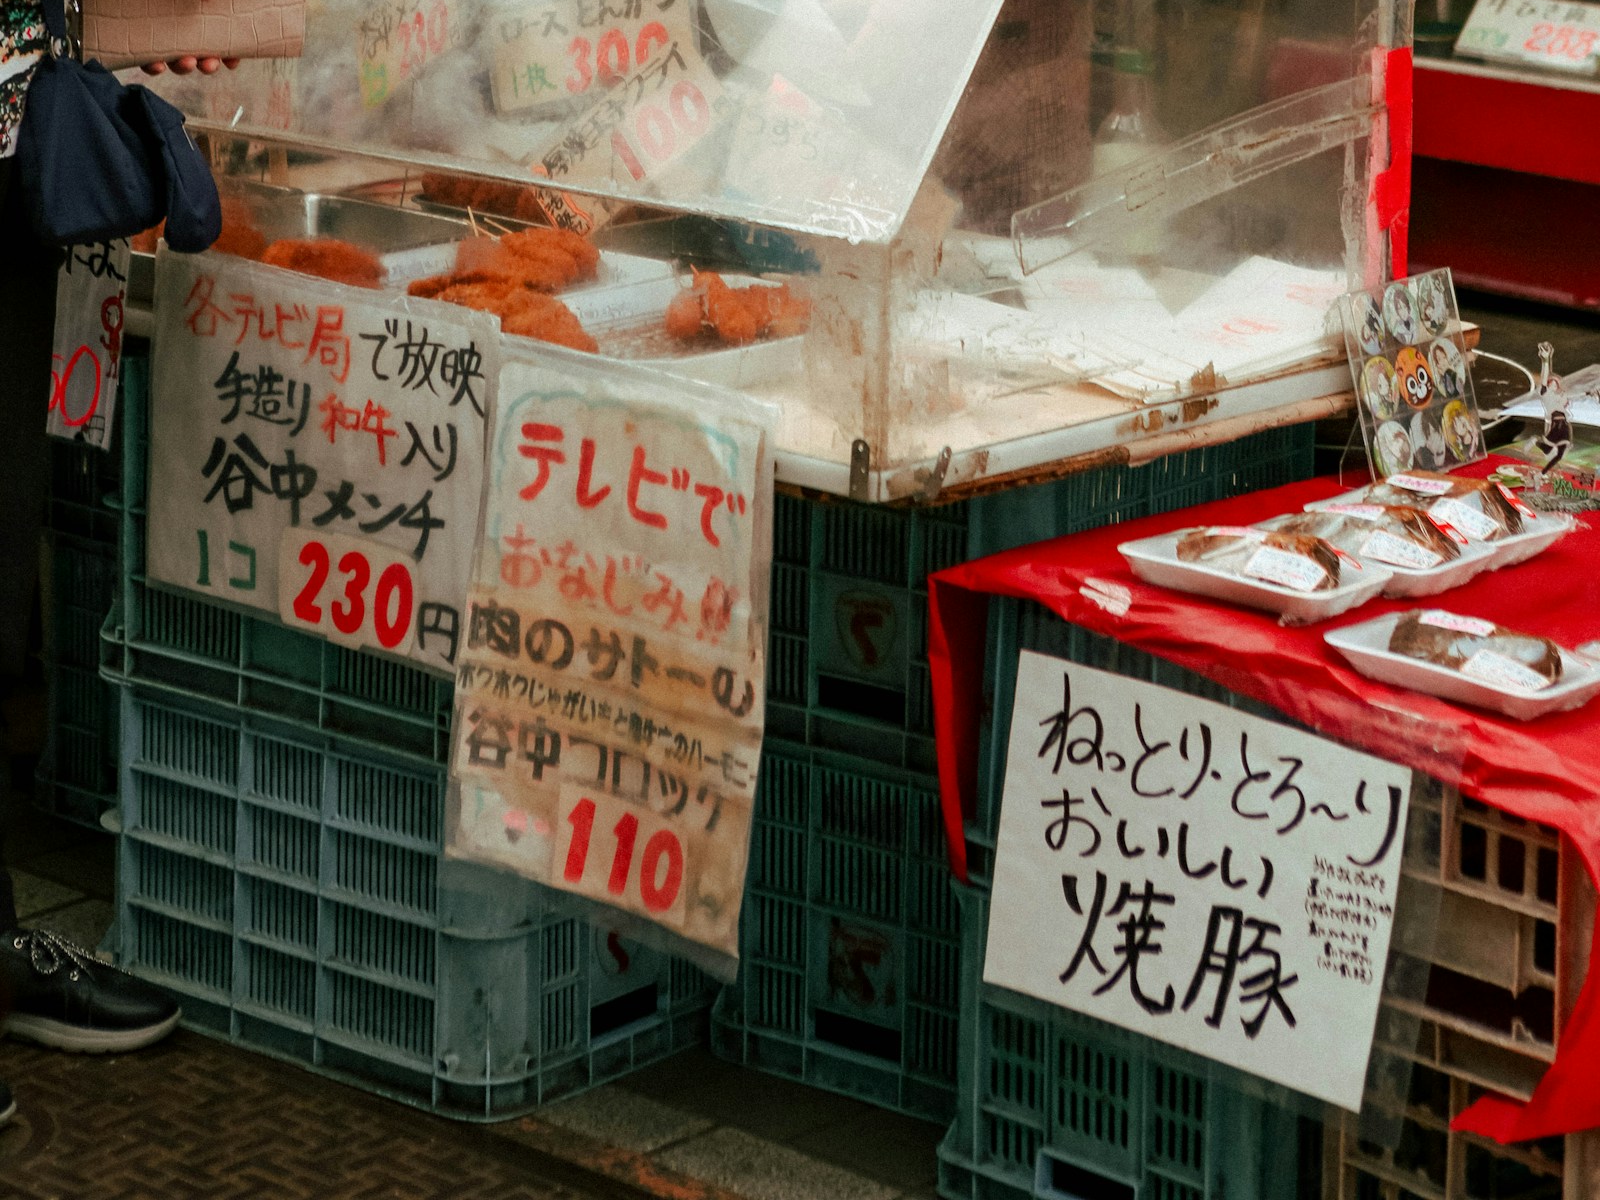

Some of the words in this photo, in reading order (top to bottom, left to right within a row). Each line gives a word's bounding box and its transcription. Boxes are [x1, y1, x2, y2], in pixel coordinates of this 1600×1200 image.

[184, 275, 487, 418] 各テレビ局で放映
[213, 350, 459, 482] 手造り和牛入り
[202, 432, 446, 563] 谷中メンチ
[516, 421, 747, 548] テレビで
[466, 598, 757, 720] 肉のサトーの
[562, 797, 684, 913] 110
[1040, 786, 1275, 899] おいしい
[1059, 870, 1300, 1041] 焼豚
